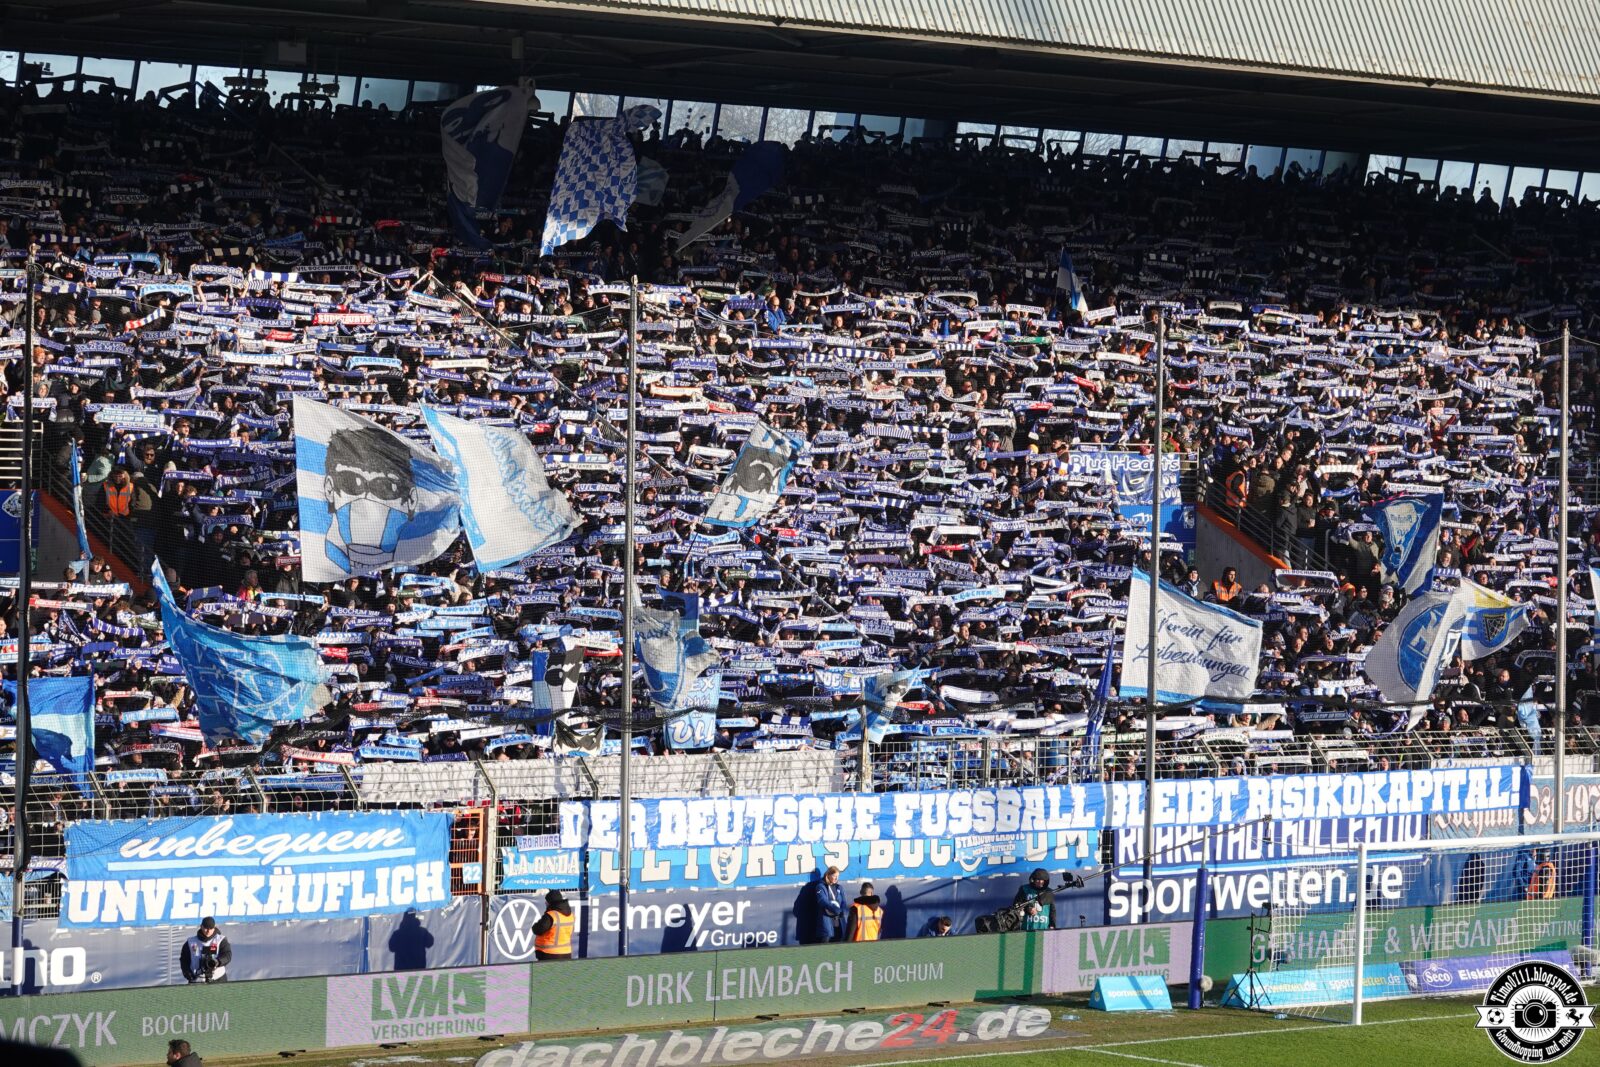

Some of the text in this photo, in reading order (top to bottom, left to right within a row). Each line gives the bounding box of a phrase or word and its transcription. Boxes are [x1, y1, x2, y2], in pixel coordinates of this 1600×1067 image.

[430, 369, 461, 379] Bochum
[1113, 454, 1181, 472] Heats
[1069, 475, 1100, 483] BOCHUM
[718, 606, 743, 618] Bochum
[881, 619, 914, 631] BOCHUM
[1206, 625, 1243, 652] für
[125, 648, 151, 656] Bochum
[755, 739, 806, 749] BOCHUM
[560, 768, 1522, 849] DER DEUTSCHE FUSSBALL BLEIBT RISIKOKAPITAL!
[119, 819, 404, 865] unbequem
[464, 866, 481, 883] 22
[509, 853, 528, 875] LA
[67, 861, 446, 922] UNVERKÄUFLICH
[1108, 865, 1403, 924] sporwetten.de
[565, 899, 751, 947] Tiemeyer
[1026, 915, 1049, 923] HOST
[710, 929, 778, 948] Gruppe
[1410, 919, 1518, 951] WIEGAND
[1079, 929, 1141, 970] LVM
[626, 961, 943, 1007] DIRK LEIMBACH BOCHUM
[1425, 969, 1451, 984] Seco
[371, 972, 448, 1021] LVM
[142, 1011, 229, 1036] BOCHUM
[372, 1018, 486, 1041] VERSICHERUNG
[477, 1004, 1052, 1067] dachbleche24.de
